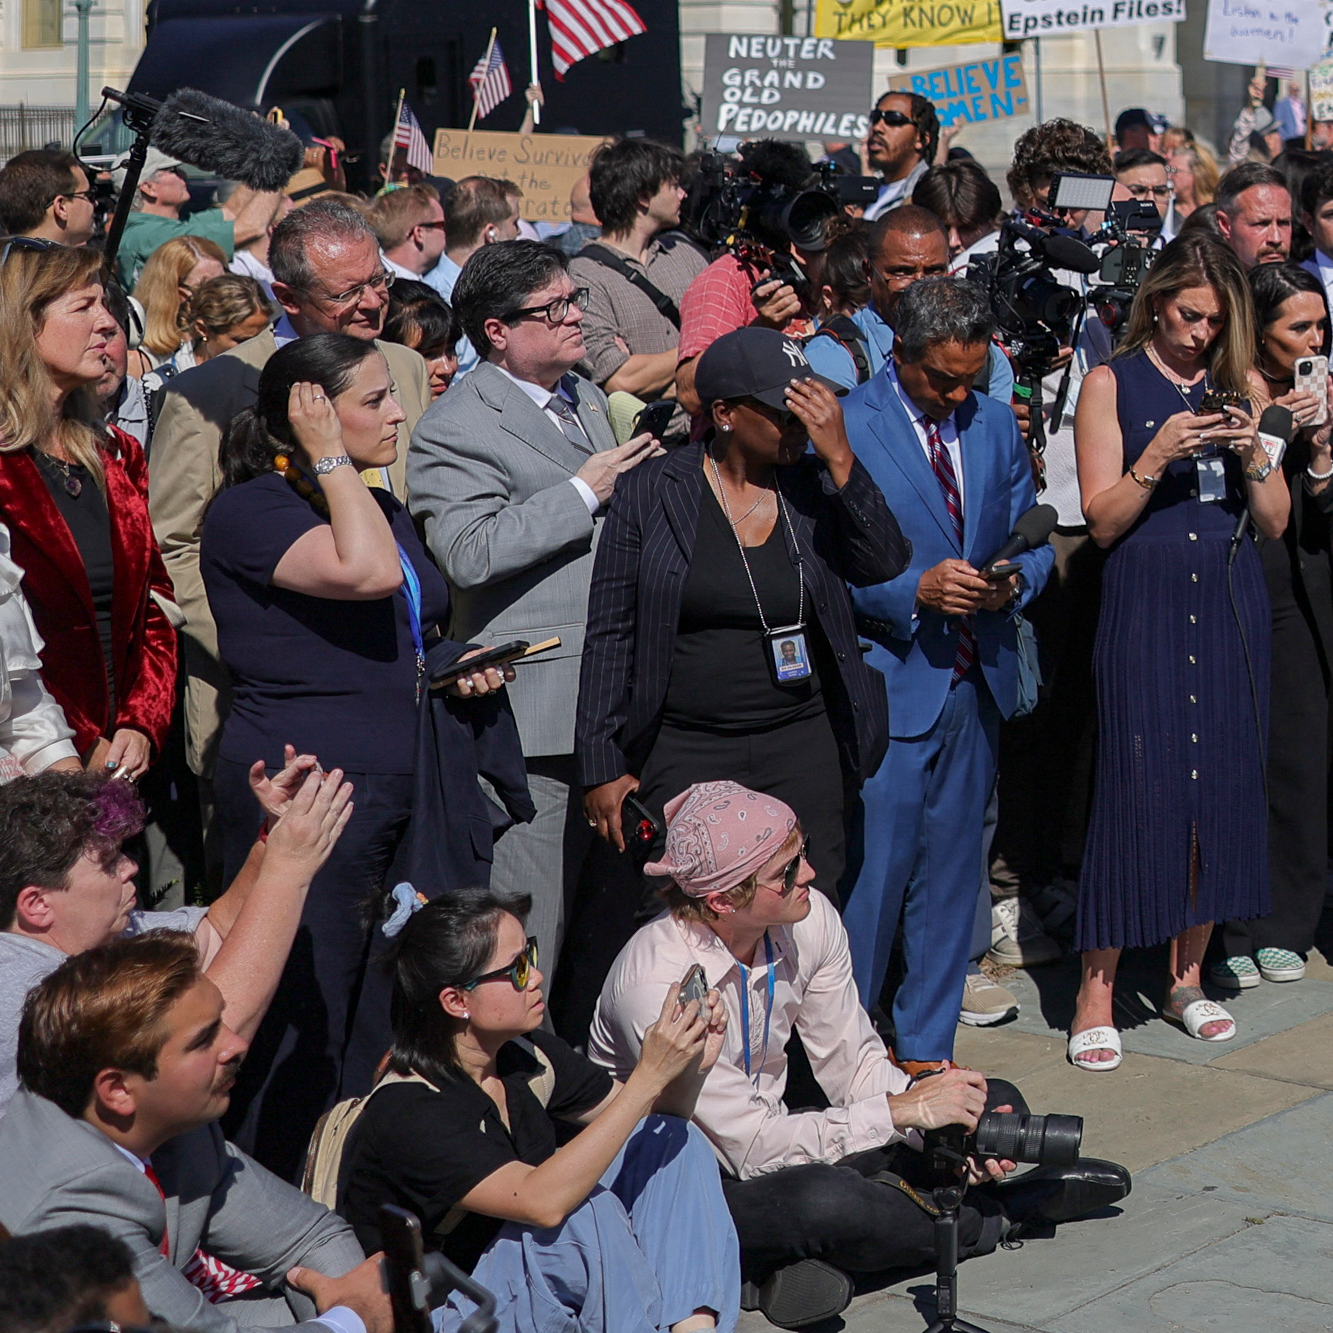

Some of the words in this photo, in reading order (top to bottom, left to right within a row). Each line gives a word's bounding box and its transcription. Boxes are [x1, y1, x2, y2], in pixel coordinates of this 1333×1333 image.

[833, 10, 889, 35] THEY
[903, 4, 975, 29] KNOW
[1007, 4, 1104, 36] Epstein
[728, 35, 837, 61] NEUTER
[770, 58, 796, 69] THE
[910, 55, 1022, 101] BELIEVE
[722, 67, 826, 90] GRAND
[723, 86, 782, 104] OLD
[935, 91, 1015, 127] OMEN
[716, 102, 870, 139] PEDOPHILES
[437, 132, 508, 163] Believe
[518, 169, 552, 190] the
[782, 340, 808, 367] NY
